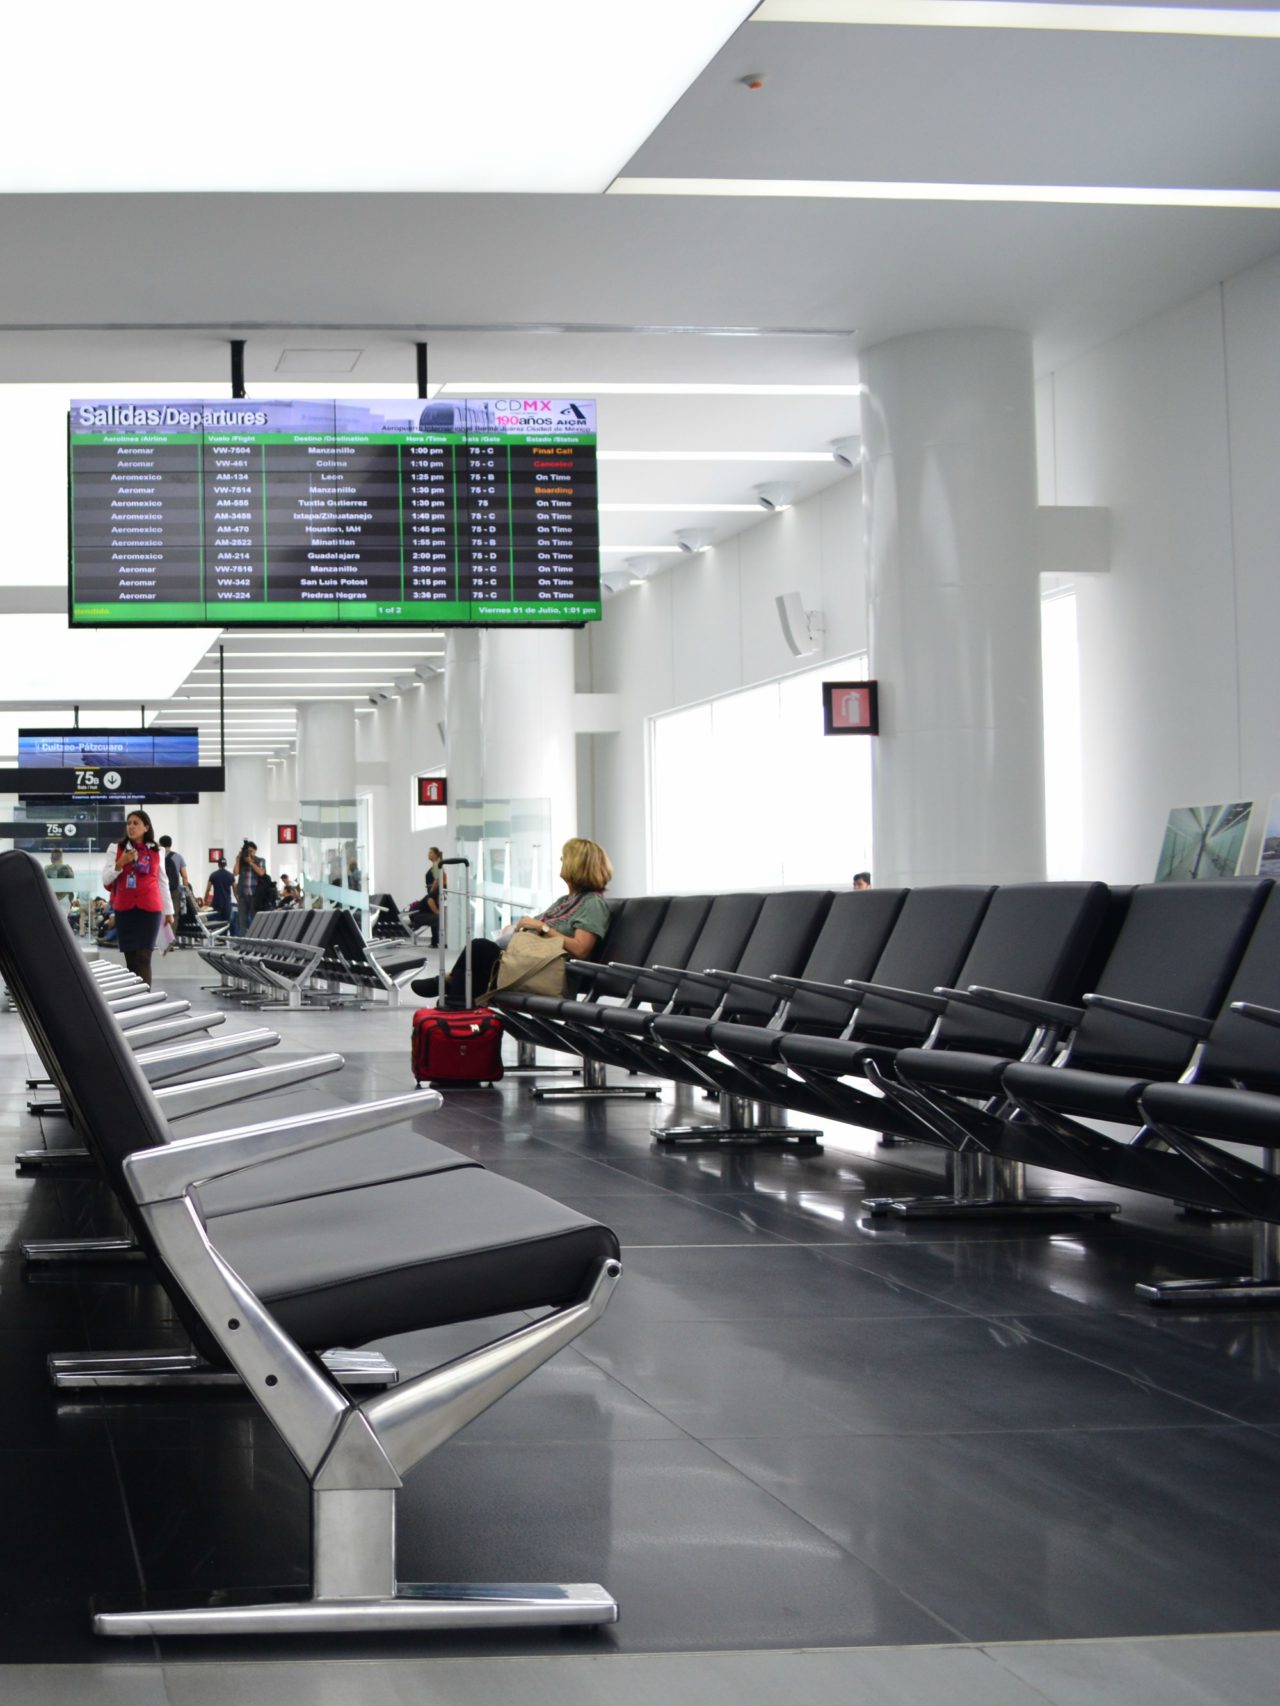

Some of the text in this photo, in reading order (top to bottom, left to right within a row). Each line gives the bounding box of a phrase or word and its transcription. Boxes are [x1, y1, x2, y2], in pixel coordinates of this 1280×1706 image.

[495, 400, 551, 411] CDMX
[79, 406, 267, 429] Salidas/Departures
[496, 415, 553, 425] 190años
[117, 460, 154, 468] Aeromar
[111, 473, 162, 481] Aeromexico
[216, 473, 248, 481] AM-134
[411, 473, 429, 481] 1:25
[470, 473, 481, 481] 75
[487, 473, 495, 481] B
[535, 473, 548, 481] On
[550, 473, 571, 481] Time
[118, 486, 154, 494] Aeromar
[309, 486, 356, 494] Manzanillo
[411, 486, 429, 494] 1:30
[470, 486, 481, 494] 75
[488, 486, 495, 494] C
[534, 486, 573, 495] Boarding
[111, 499, 162, 507] Aeromexico
[298, 499, 325, 507] Tuxtla
[326, 499, 367, 507] Gutierrez
[411, 499, 429, 507] 1:30
[478, 499, 489, 507] 75
[536, 499, 549, 507] On
[550, 499, 572, 507] Time
[111, 512, 163, 520] Aeromexico
[293, 512, 372, 521] Ixtapa/Zihuatanejo
[411, 512, 429, 520] 1:40
[470, 512, 481, 520] 75
[488, 512, 495, 520] C
[536, 512, 549, 520] On
[551, 512, 572, 520] Time
[217, 525, 249, 533] AM-470
[305, 525, 344, 534] Houston,
[346, 525, 361, 533] IAH
[412, 525, 430, 533] 1:45
[471, 525, 482, 533] 75
[489, 525, 496, 533] D
[537, 525, 549, 533] On
[551, 525, 572, 533] Time
[111, 552, 573, 561] Aeromexico AM-214 Guadalajara 2:00 pm 75 D On Time
[119, 565, 156, 573] Aeromar
[310, 565, 358, 573] Manzanillo
[412, 565, 430, 573] 2:00
[472, 565, 483, 573] 75
[489, 565, 497, 573] C
[538, 565, 550, 573] On
[552, 565, 573, 573] Time
[119, 578, 156, 586] Aeromar
[217, 578, 250, 586] VW-342
[300, 578, 317, 586] San
[319, 578, 338, 586] Luis
[472, 578, 483, 586] 75
[490, 578, 497, 586] C
[538, 578, 551, 586] On
[552, 578, 574, 586] Time
[301, 591, 334, 599] Piedras
[336, 591, 367, 600] Negras
[472, 591, 483, 599] 75
[490, 591, 497, 599] C
[538, 591, 551, 599] On
[553, 591, 574, 599] Time
[537, 607, 561, 615] Julio,
[75, 771, 99, 785] 75B
